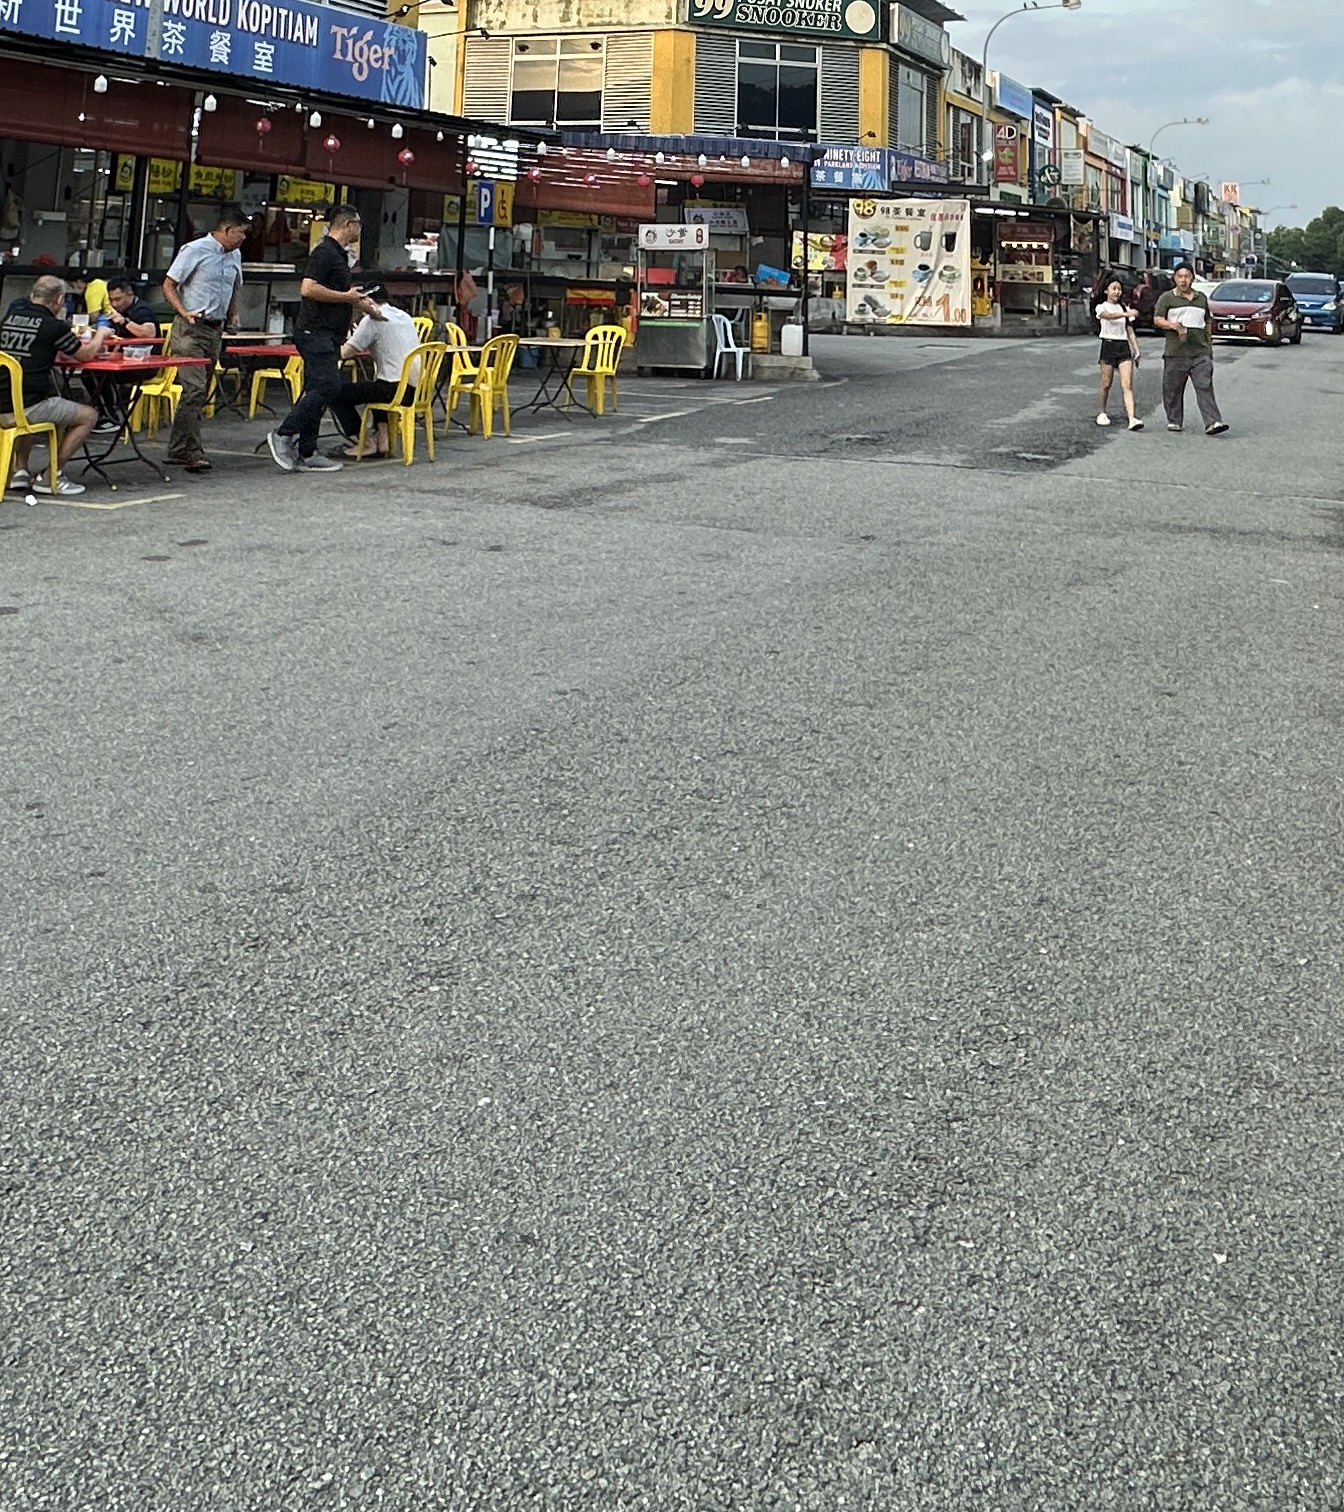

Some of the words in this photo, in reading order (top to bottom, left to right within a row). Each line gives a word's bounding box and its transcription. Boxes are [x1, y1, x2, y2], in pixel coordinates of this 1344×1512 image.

[735, 4, 842, 31] SNOOKER
[330, 24, 395, 81] Tiger
[996, 125, 1016, 140] 4D
[856, 151, 881, 163] EIGHT
[480, 188, 491, 217] P
[4, 314, 43, 329] ADIDAS
[0, 331, 37, 352] 9717
